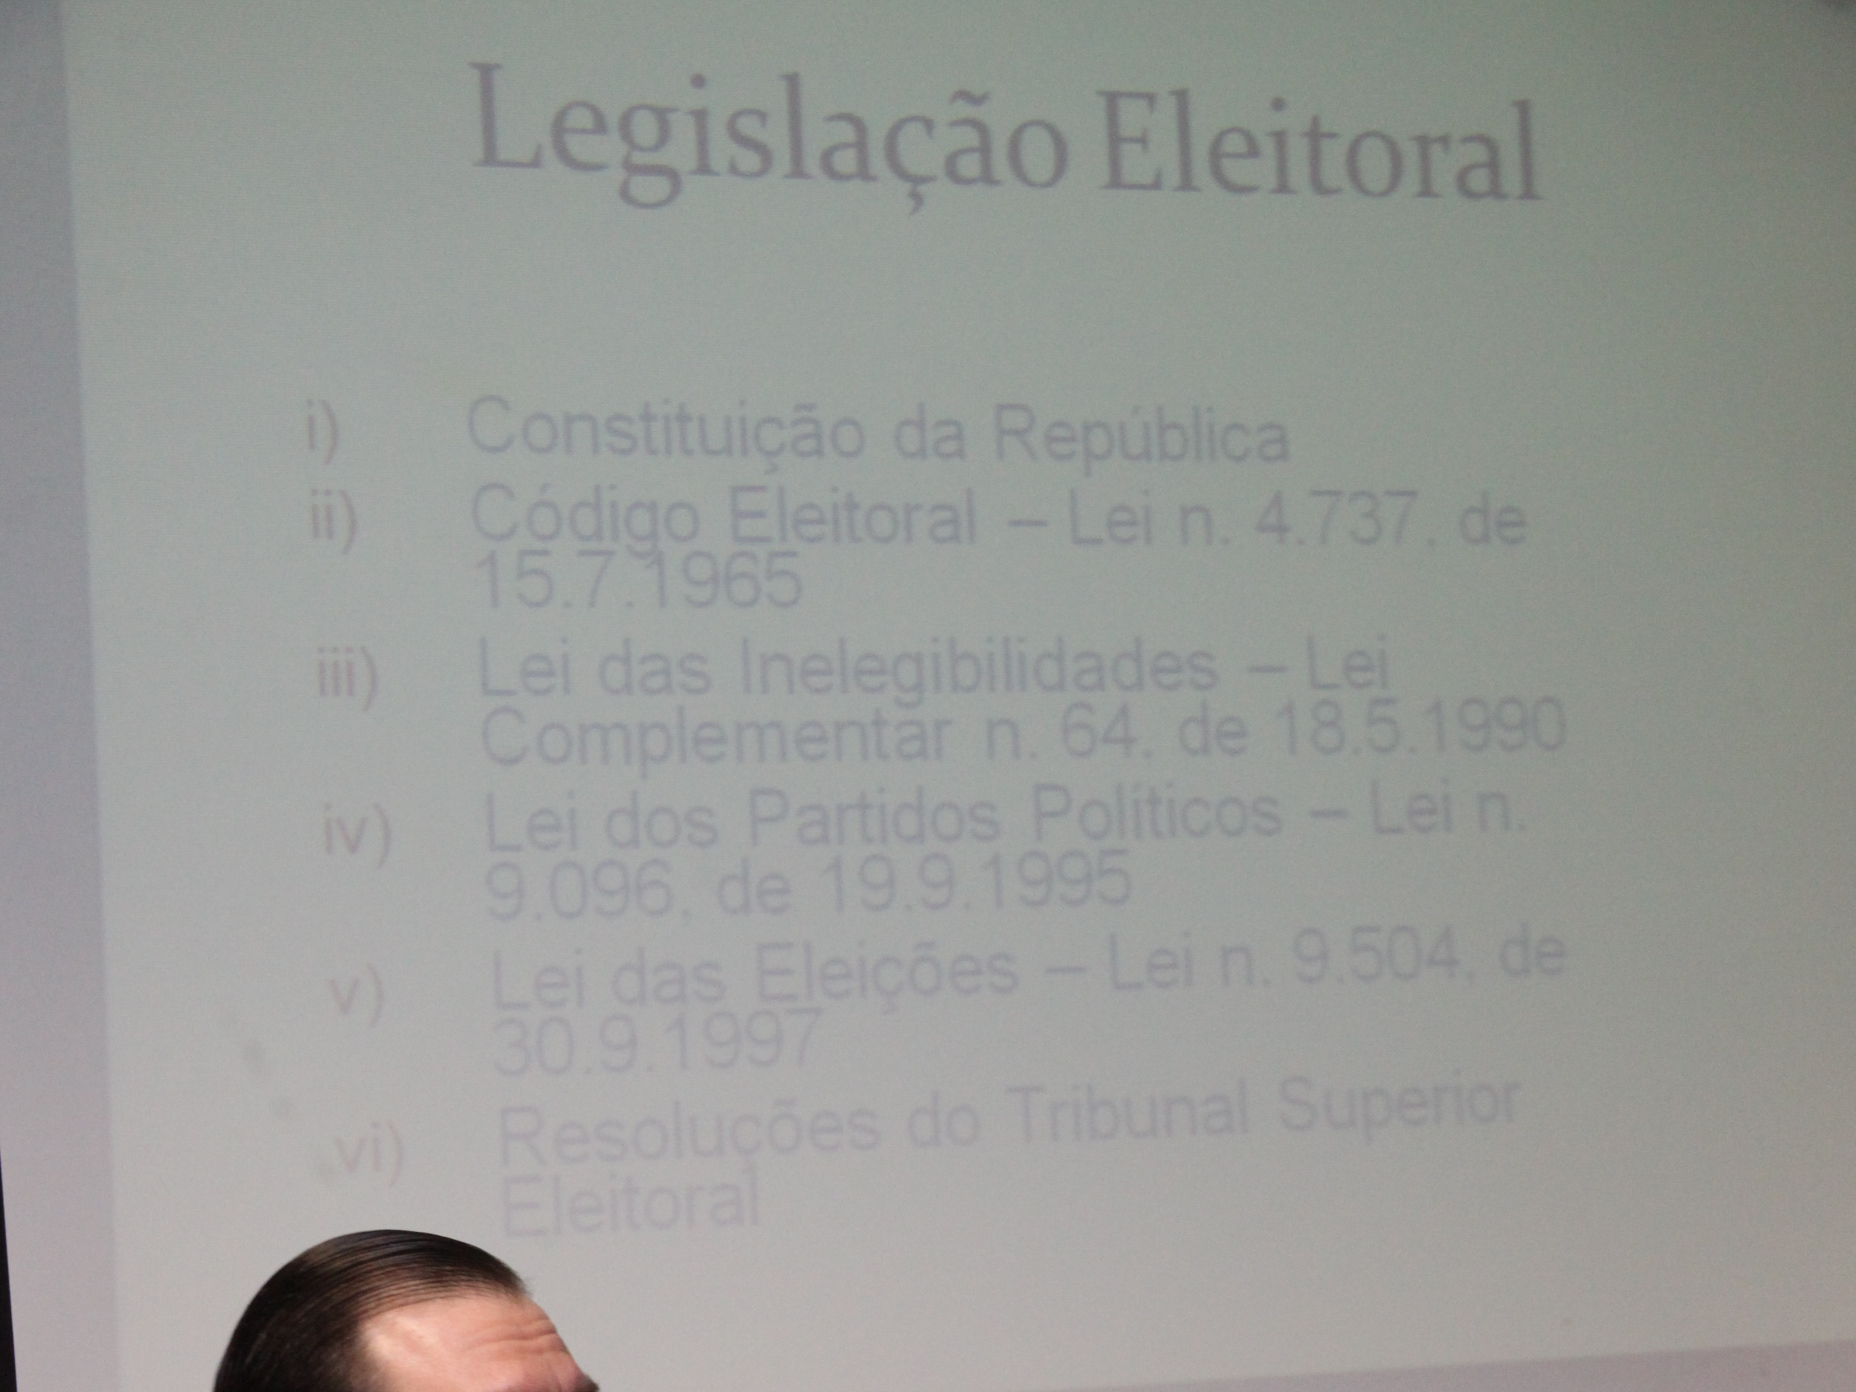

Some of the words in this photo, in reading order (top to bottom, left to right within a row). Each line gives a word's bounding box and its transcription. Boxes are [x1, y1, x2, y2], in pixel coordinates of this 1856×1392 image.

[467, 61, 1071, 216] Legislação
[1095, 87, 1547, 201] Eleitoral
[304, 397, 341, 466] i)
[466, 394, 866, 475] Constituição
[893, 402, 967, 461] da
[993, 403, 1291, 478] República
[310, 487, 359, 556] ii)
[470, 482, 701, 560] Código
[729, 484, 976, 545] Eleitoral
[1068, 487, 1154, 546] Lei
[1179, 502, 1231, 546] n.
[1457, 488, 1529, 547] de
[475, 547, 803, 609] 15.7.1965
[316, 645, 381, 711] iii)
[478, 636, 571, 697] Lei
[599, 636, 713, 697] das
[742, 635, 1219, 709] Inelegibilidades
[1306, 632, 1390, 690] Lei
[481, 703, 952, 780] Complementar
[985, 716, 1038, 760] n.
[1177, 700, 1249, 757] de
[1274, 695, 1568, 757] 18.5.1990
[323, 801, 394, 870] iv)
[485, 789, 579, 853] Lei
[603, 789, 719, 850] dos
[749, 783, 1001, 847] Partidos
[1370, 777, 1453, 834] Lei
[1476, 788, 1527, 832] n.
[716, 856, 793, 915] de
[819, 848, 1133, 912] 19.9.1995
[325, 962, 385, 1028] v)
[493, 948, 585, 1011] Lei
[610, 946, 727, 1007] das
[755, 940, 1020, 1015] Eleições
[1109, 932, 1195, 992] Lei
[1219, 943, 1273, 987] n.
[1499, 921, 1568, 978] de
[493, 1005, 825, 1076] 30.9.1997
[334, 1119, 406, 1187] vi)
[499, 1097, 882, 1170] Resoluções
[906, 1089, 981, 1148] do
[1005, 1076, 1250, 1143] Tribunal
[1278, 1068, 1523, 1144] Superior
[501, 1162, 760, 1238] Eleitoral
